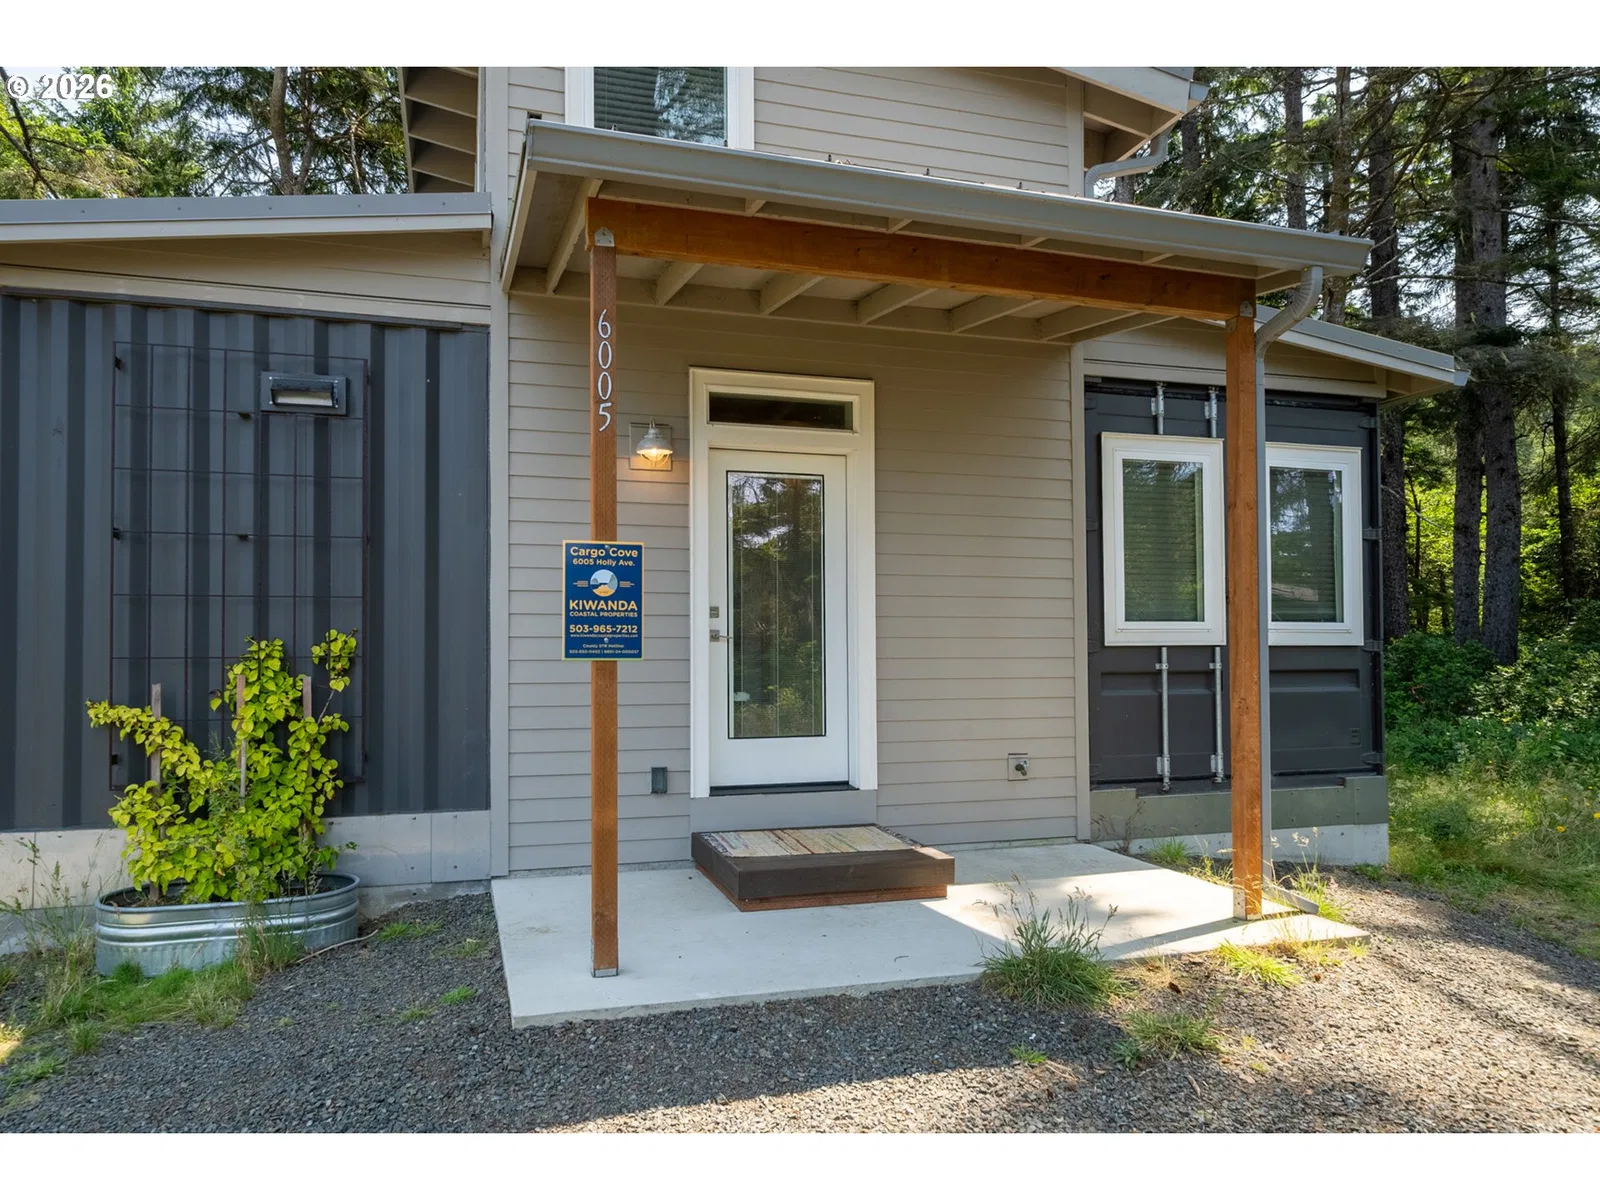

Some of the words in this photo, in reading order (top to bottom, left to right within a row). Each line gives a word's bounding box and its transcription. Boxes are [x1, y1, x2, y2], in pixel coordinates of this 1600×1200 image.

[598, 309, 612, 431] 6005
[570, 546, 606, 558] Cargo
[609, 547, 638, 557] Cove
[596, 559, 617, 567] Holly
[569, 600, 638, 611] KIWANDA
[569, 624, 638, 633] 503-965-7212
